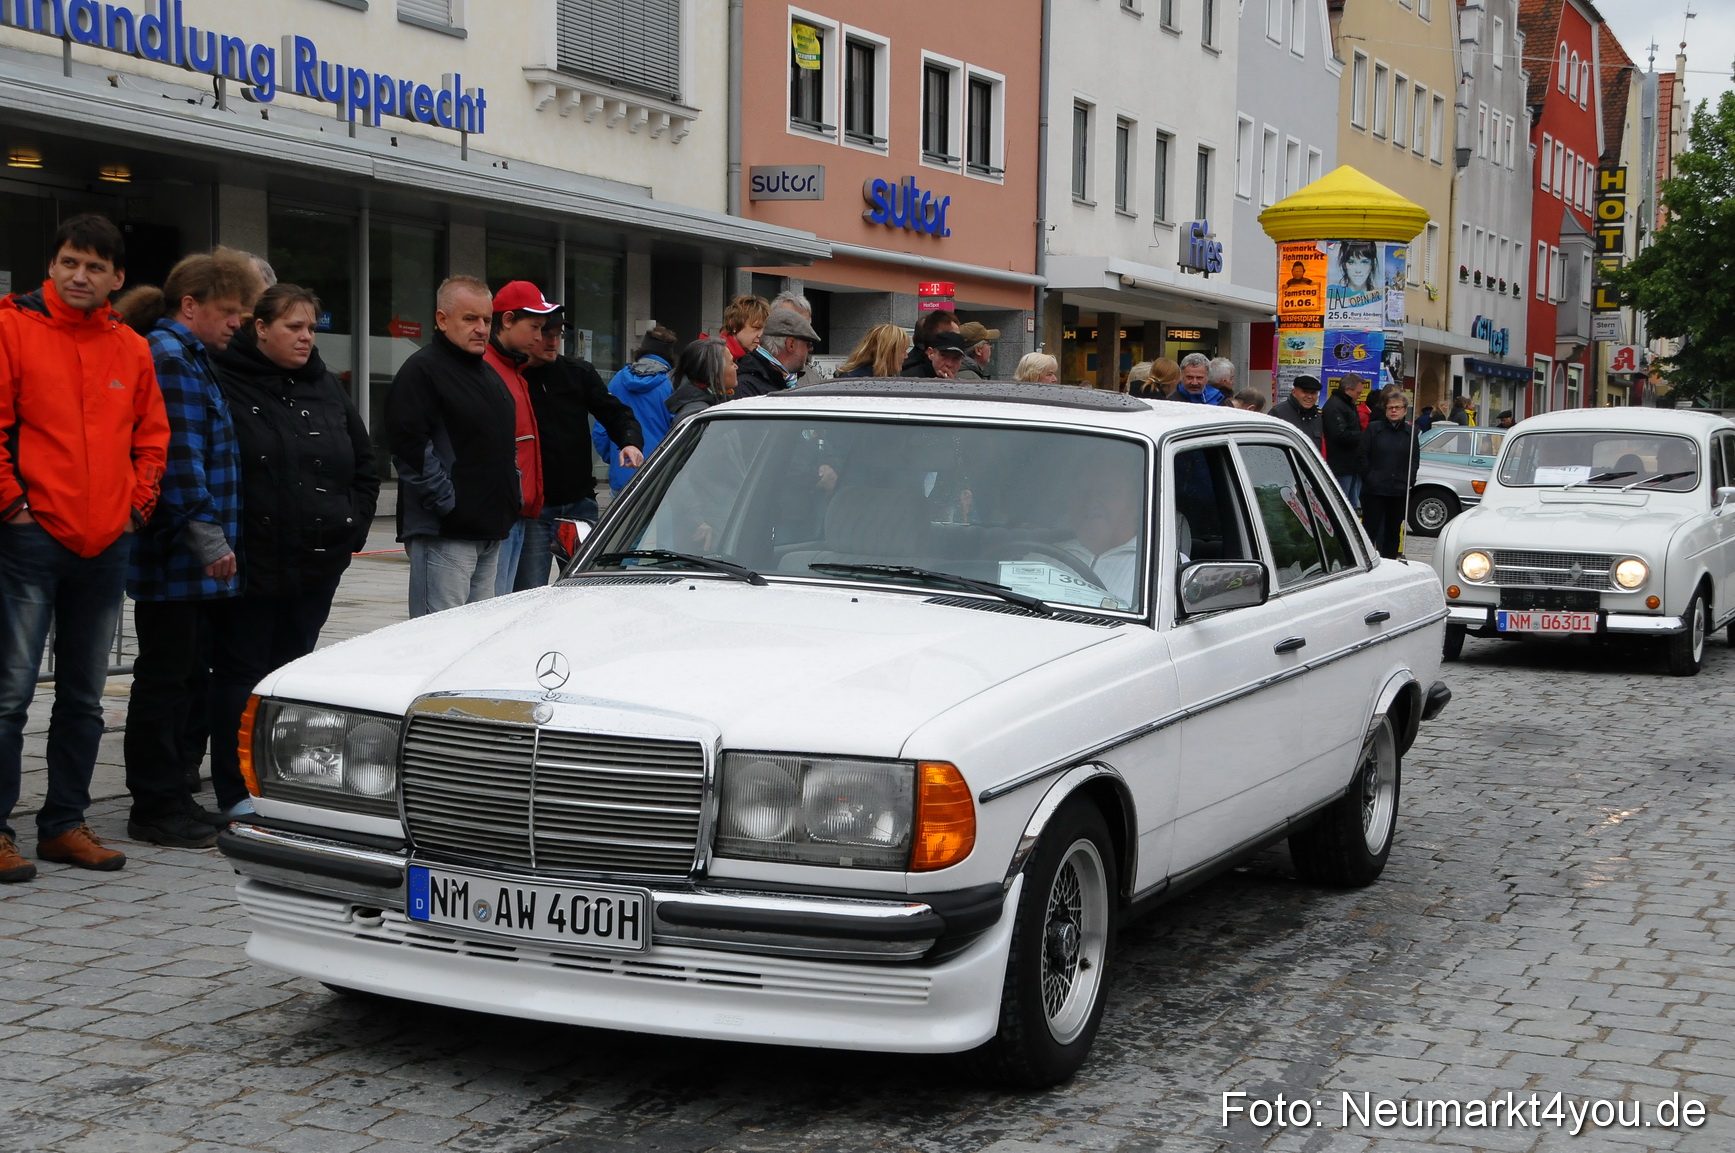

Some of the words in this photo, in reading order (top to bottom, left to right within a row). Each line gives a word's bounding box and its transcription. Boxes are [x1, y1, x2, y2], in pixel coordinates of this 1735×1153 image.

[287, 35, 486, 134] Rupprecht
[1597, 170, 1625, 309] HOTEL
[1282, 253, 1325, 261] Flohmarkt
[1284, 289, 1317, 297] Samstag
[1284, 299, 1315, 308] 01.06.
[1350, 294, 1370, 307] OPEN
[1167, 330, 1201, 339] FRIES
[1509, 614, 1531, 629] NM
[1541, 614, 1591, 631] 06301
[415, 898, 424, 910] D
[430, 875, 469, 920] NM
[495, 886, 537, 930] AW
[547, 892, 640, 941] 400H
